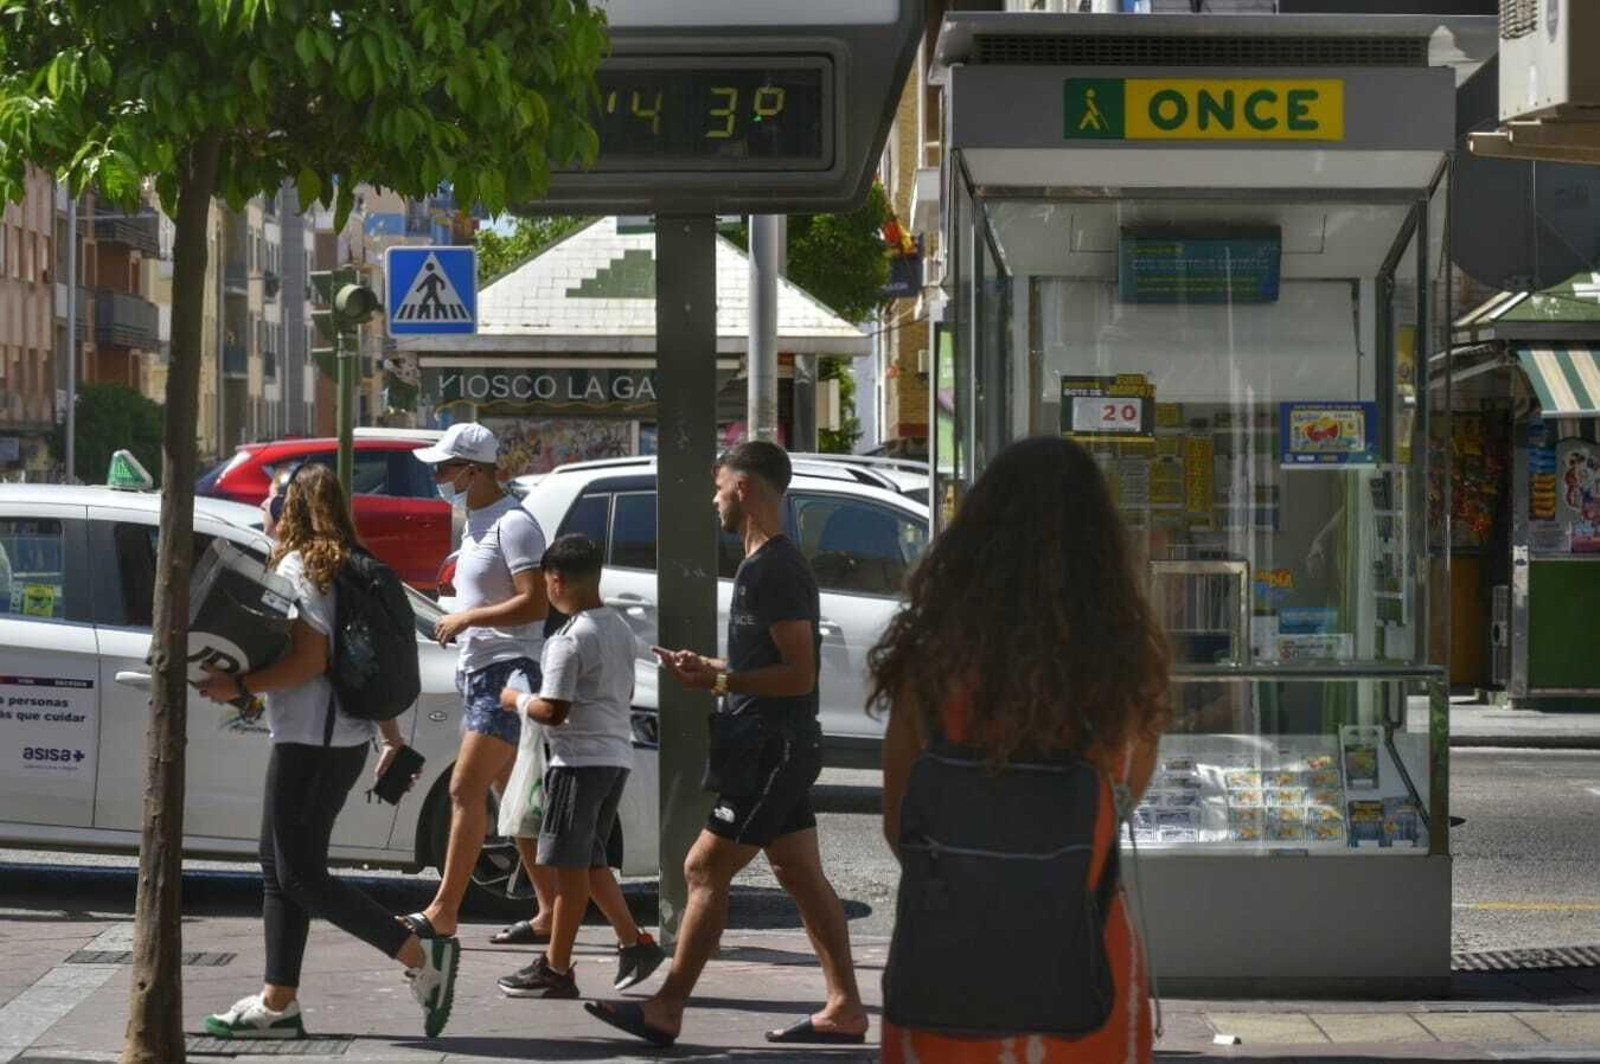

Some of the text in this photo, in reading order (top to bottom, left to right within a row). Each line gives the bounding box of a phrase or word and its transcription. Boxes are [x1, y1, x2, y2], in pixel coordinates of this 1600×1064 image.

[1148, 89, 1320, 131] ONCE
[437, 375, 557, 399] KIOSCO
[568, 376, 604, 399] LA
[1102, 404, 1137, 421] 20
[8, 696, 68, 707] personas
[17, 711, 40, 722] que
[44, 712, 86, 723] cuidar
